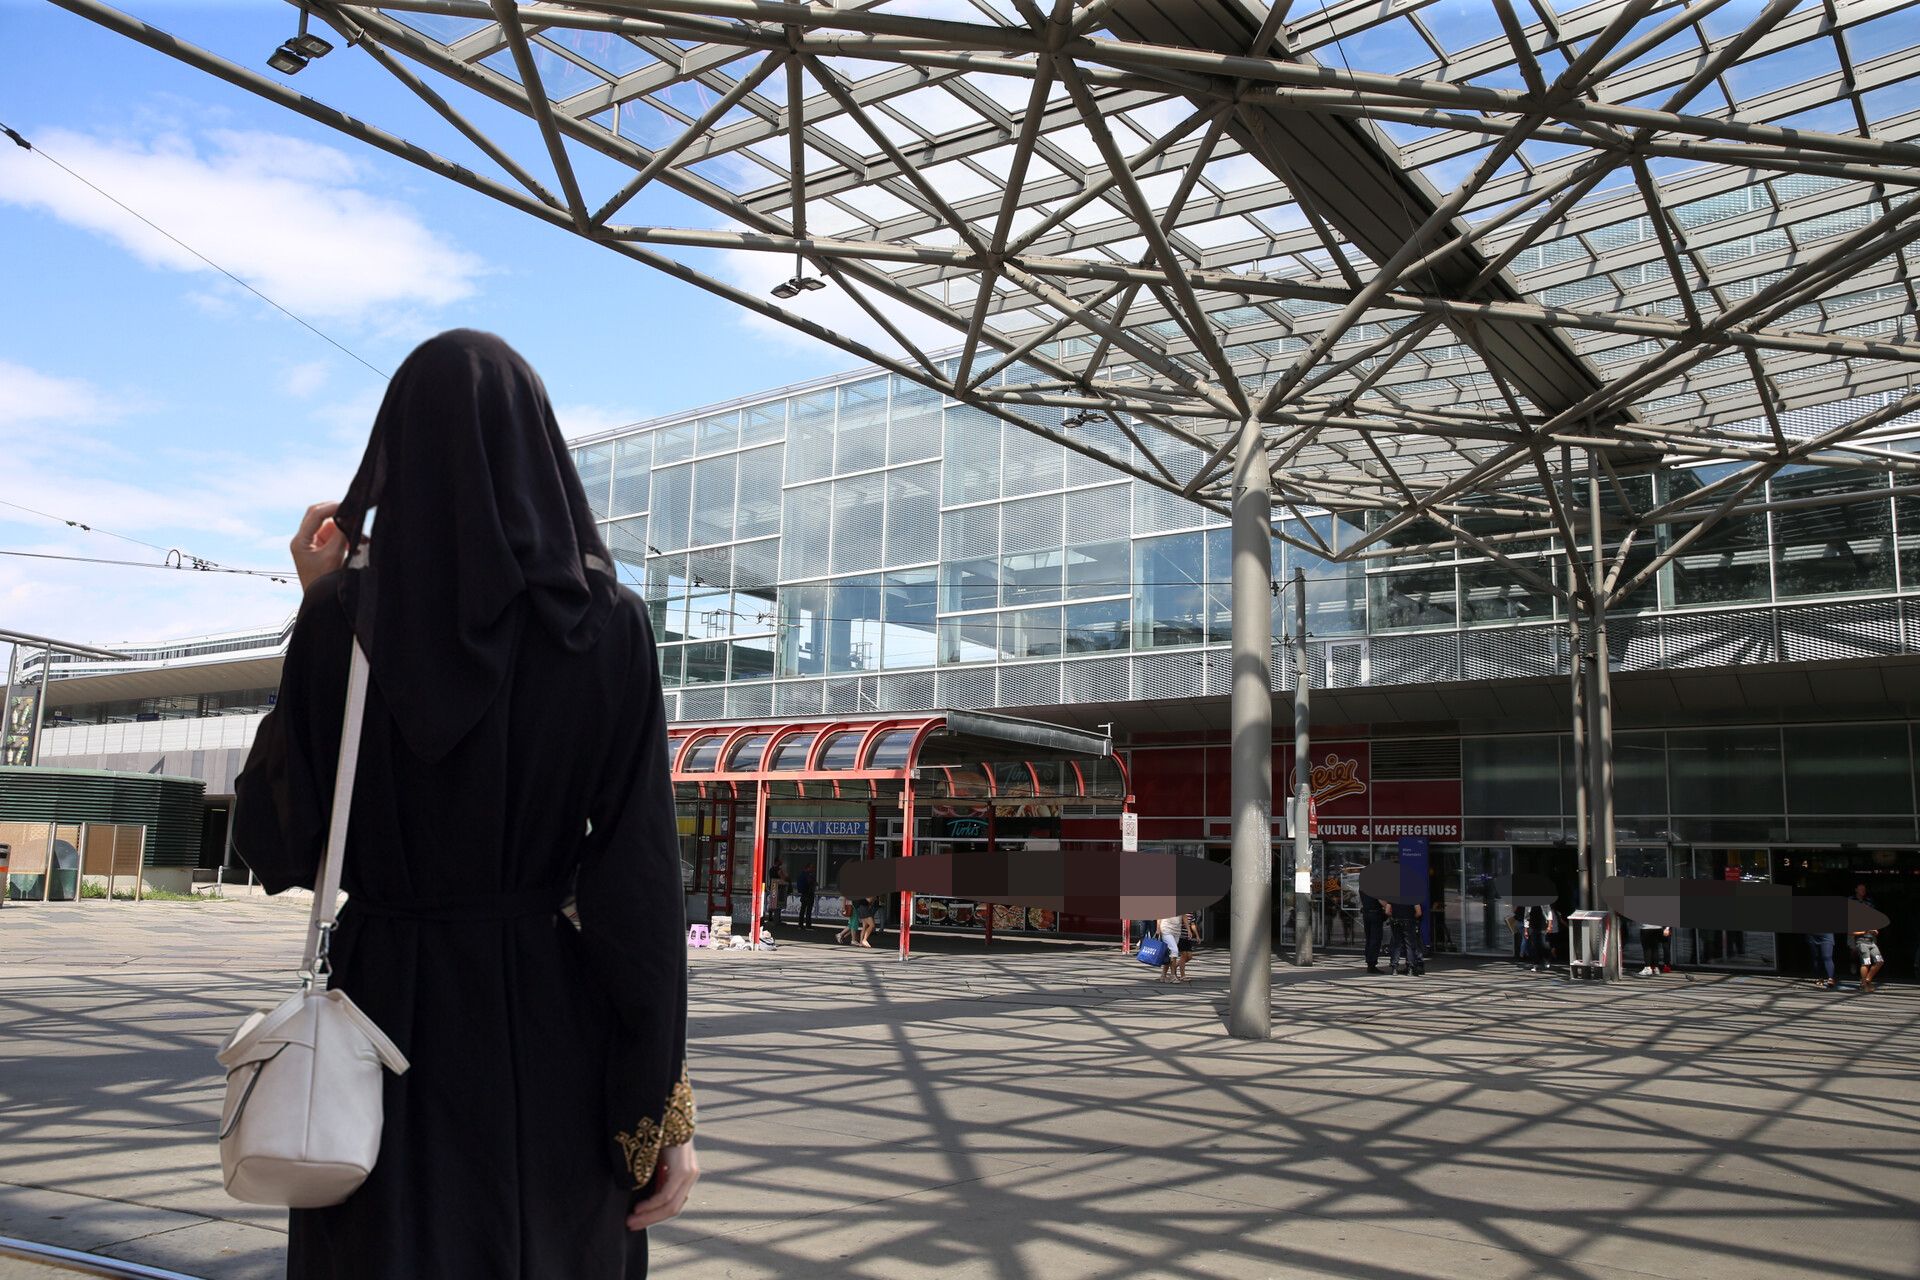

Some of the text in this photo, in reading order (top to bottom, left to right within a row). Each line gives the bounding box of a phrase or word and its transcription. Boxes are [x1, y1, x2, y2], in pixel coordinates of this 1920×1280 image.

[781, 821, 861, 834] CIVAN KEBAP
[1317, 824, 1457, 836] KULTUR & KAFFEEGENUSS
